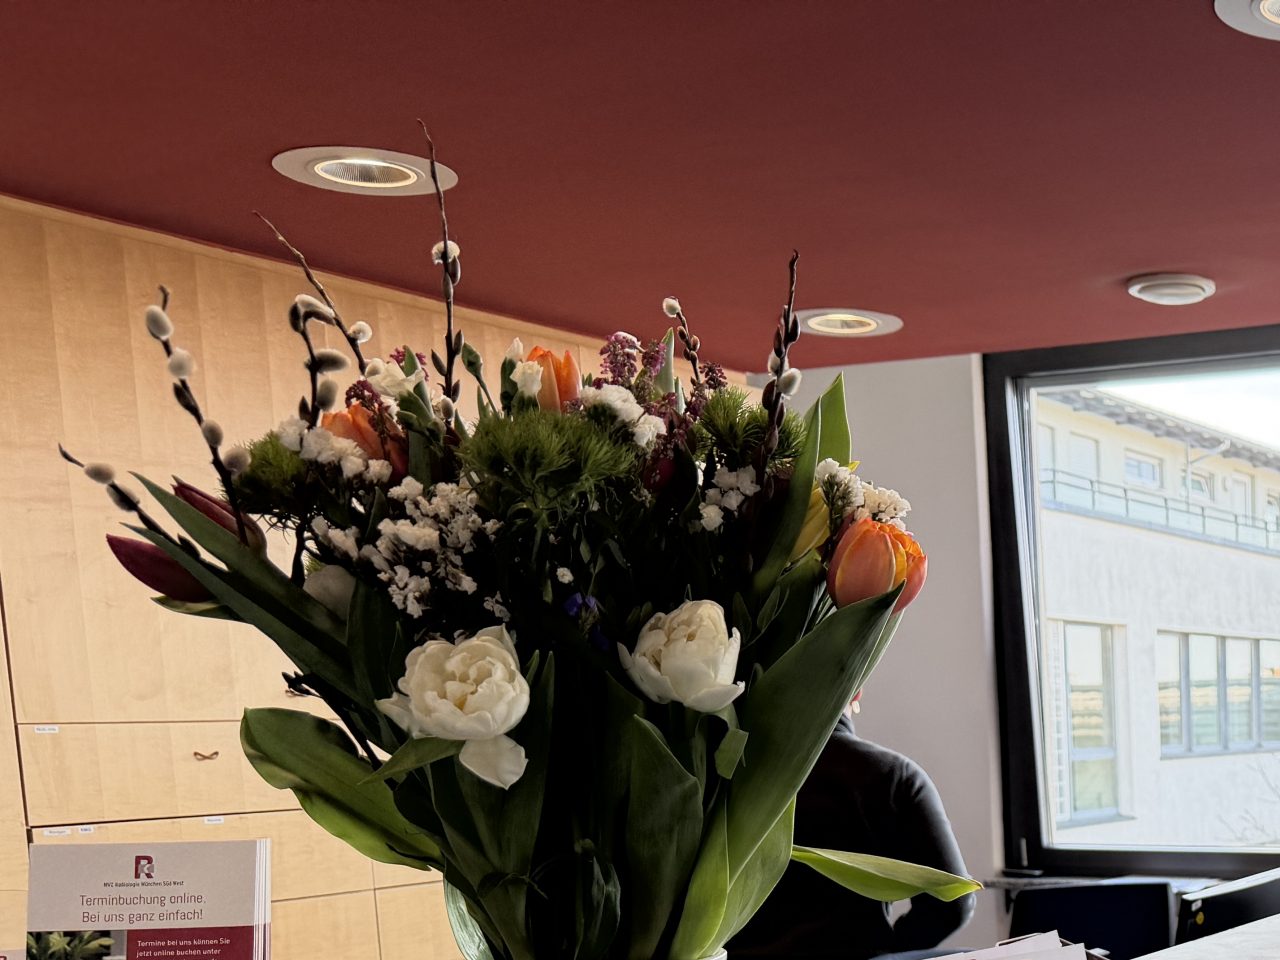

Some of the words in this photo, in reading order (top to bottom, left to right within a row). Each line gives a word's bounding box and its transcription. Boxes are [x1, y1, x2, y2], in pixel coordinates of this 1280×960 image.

[80, 894, 166, 907] Terminbuchung
[169, 893, 206, 904] online.
[82, 911, 100, 923] Bei
[104, 913, 124, 922] uns
[128, 912, 155, 925] ganz
[158, 909, 203, 921] einfach!
[137, 939, 166, 947] Termine
[219, 937, 231, 945] Sie
[136, 950, 152, 958] jetzt
[153, 949, 175, 957] online
